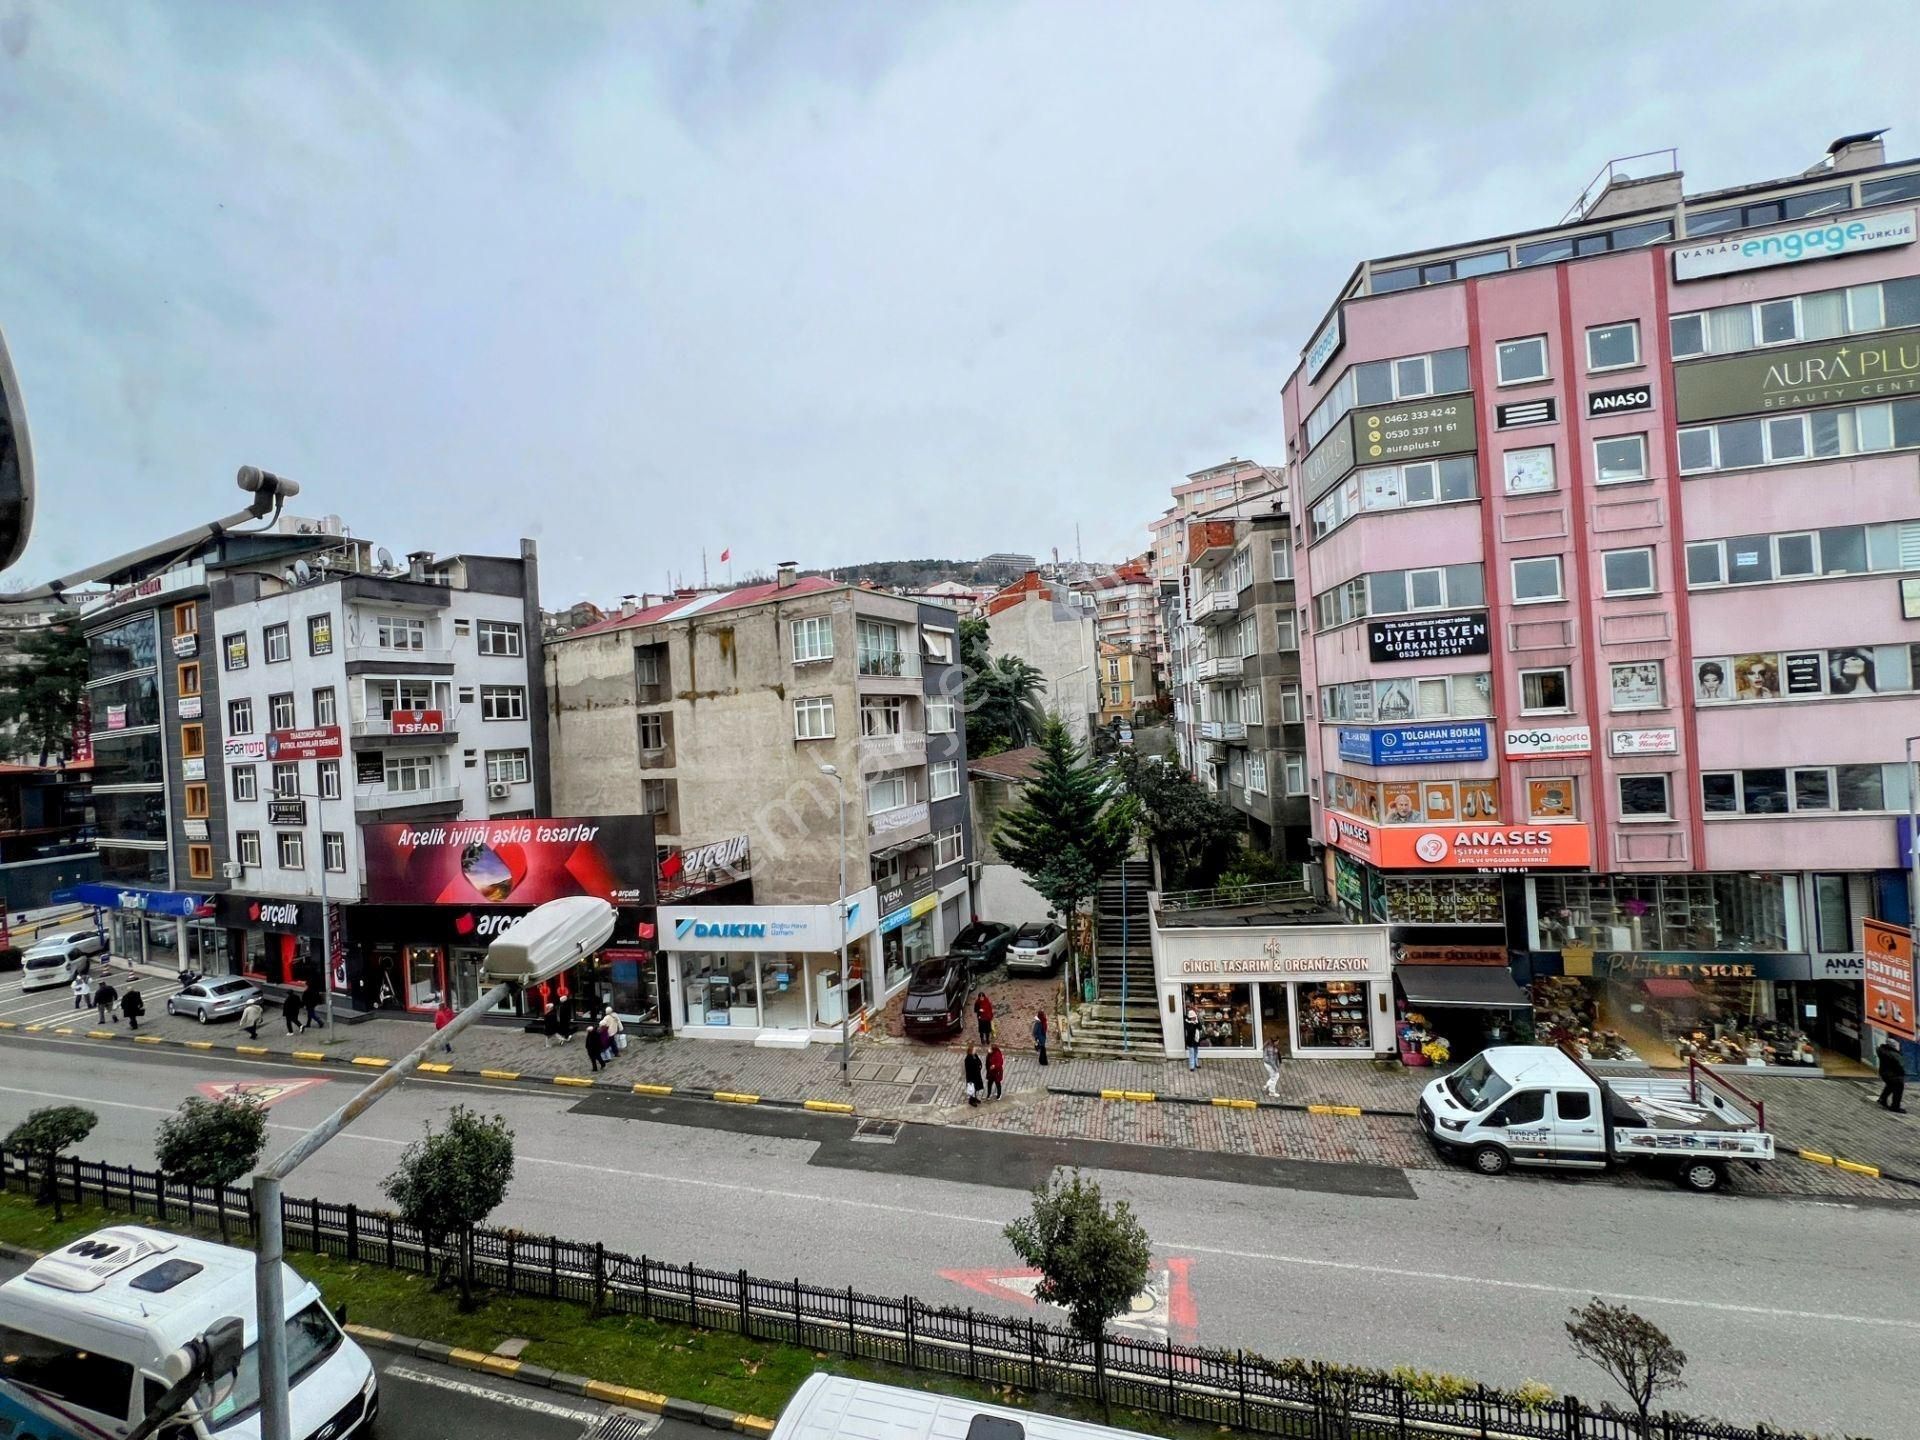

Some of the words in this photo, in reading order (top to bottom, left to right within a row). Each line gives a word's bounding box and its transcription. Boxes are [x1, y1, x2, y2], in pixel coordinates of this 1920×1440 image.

[1682, 243, 1740, 259] VANAD
[1742, 222, 1866, 259] engage
[1763, 356, 1852, 389] AURA
[1593, 391, 1648, 410] ANASO
[1765, 389, 1844, 407] BEAUTY
[1384, 413, 1409, 424] 0462
[1411, 410, 1429, 420] 333
[1430, 408, 1443, 417] 42
[1444, 406, 1457, 415] 42
[1385, 429, 1410, 439] 0530
[1412, 427, 1429, 436] 337
[1434, 424, 1443, 432] 11
[1446, 422, 1457, 431] 61
[1386, 440, 1441, 454] auraplus.tr
[1182, 564, 1192, 620] HOTEL
[1374, 624, 1485, 643] DİYETİSYEN
[1385, 641, 1437, 651] GÜRKAN
[1441, 637, 1474, 647] KURT
[396, 723, 439, 733] TSFAD
[1401, 729, 1448, 741] TOLGAHAN
[1450, 727, 1481, 738] BORAN
[398, 827, 446, 849] Arçelik
[449, 825, 489, 848] iyiliği
[492, 825, 531, 848] aşkla
[536, 823, 600, 844] tasarlar
[1339, 820, 1369, 843] ANASES
[1454, 830, 1553, 846] ANASES
[683, 836, 749, 874] arçelik
[617, 888, 641, 898] arçelik
[260, 903, 299, 927] arçelik
[694, 921, 767, 938] DAIKIN
[1222, 959, 1270, 973] TASARIM
[1273, 959, 1281, 972] &
[1284, 956, 1369, 972] ORGANİZASYON
[1867, 950, 1911, 967] ANASES
[1699, 963, 1757, 977] STORE
